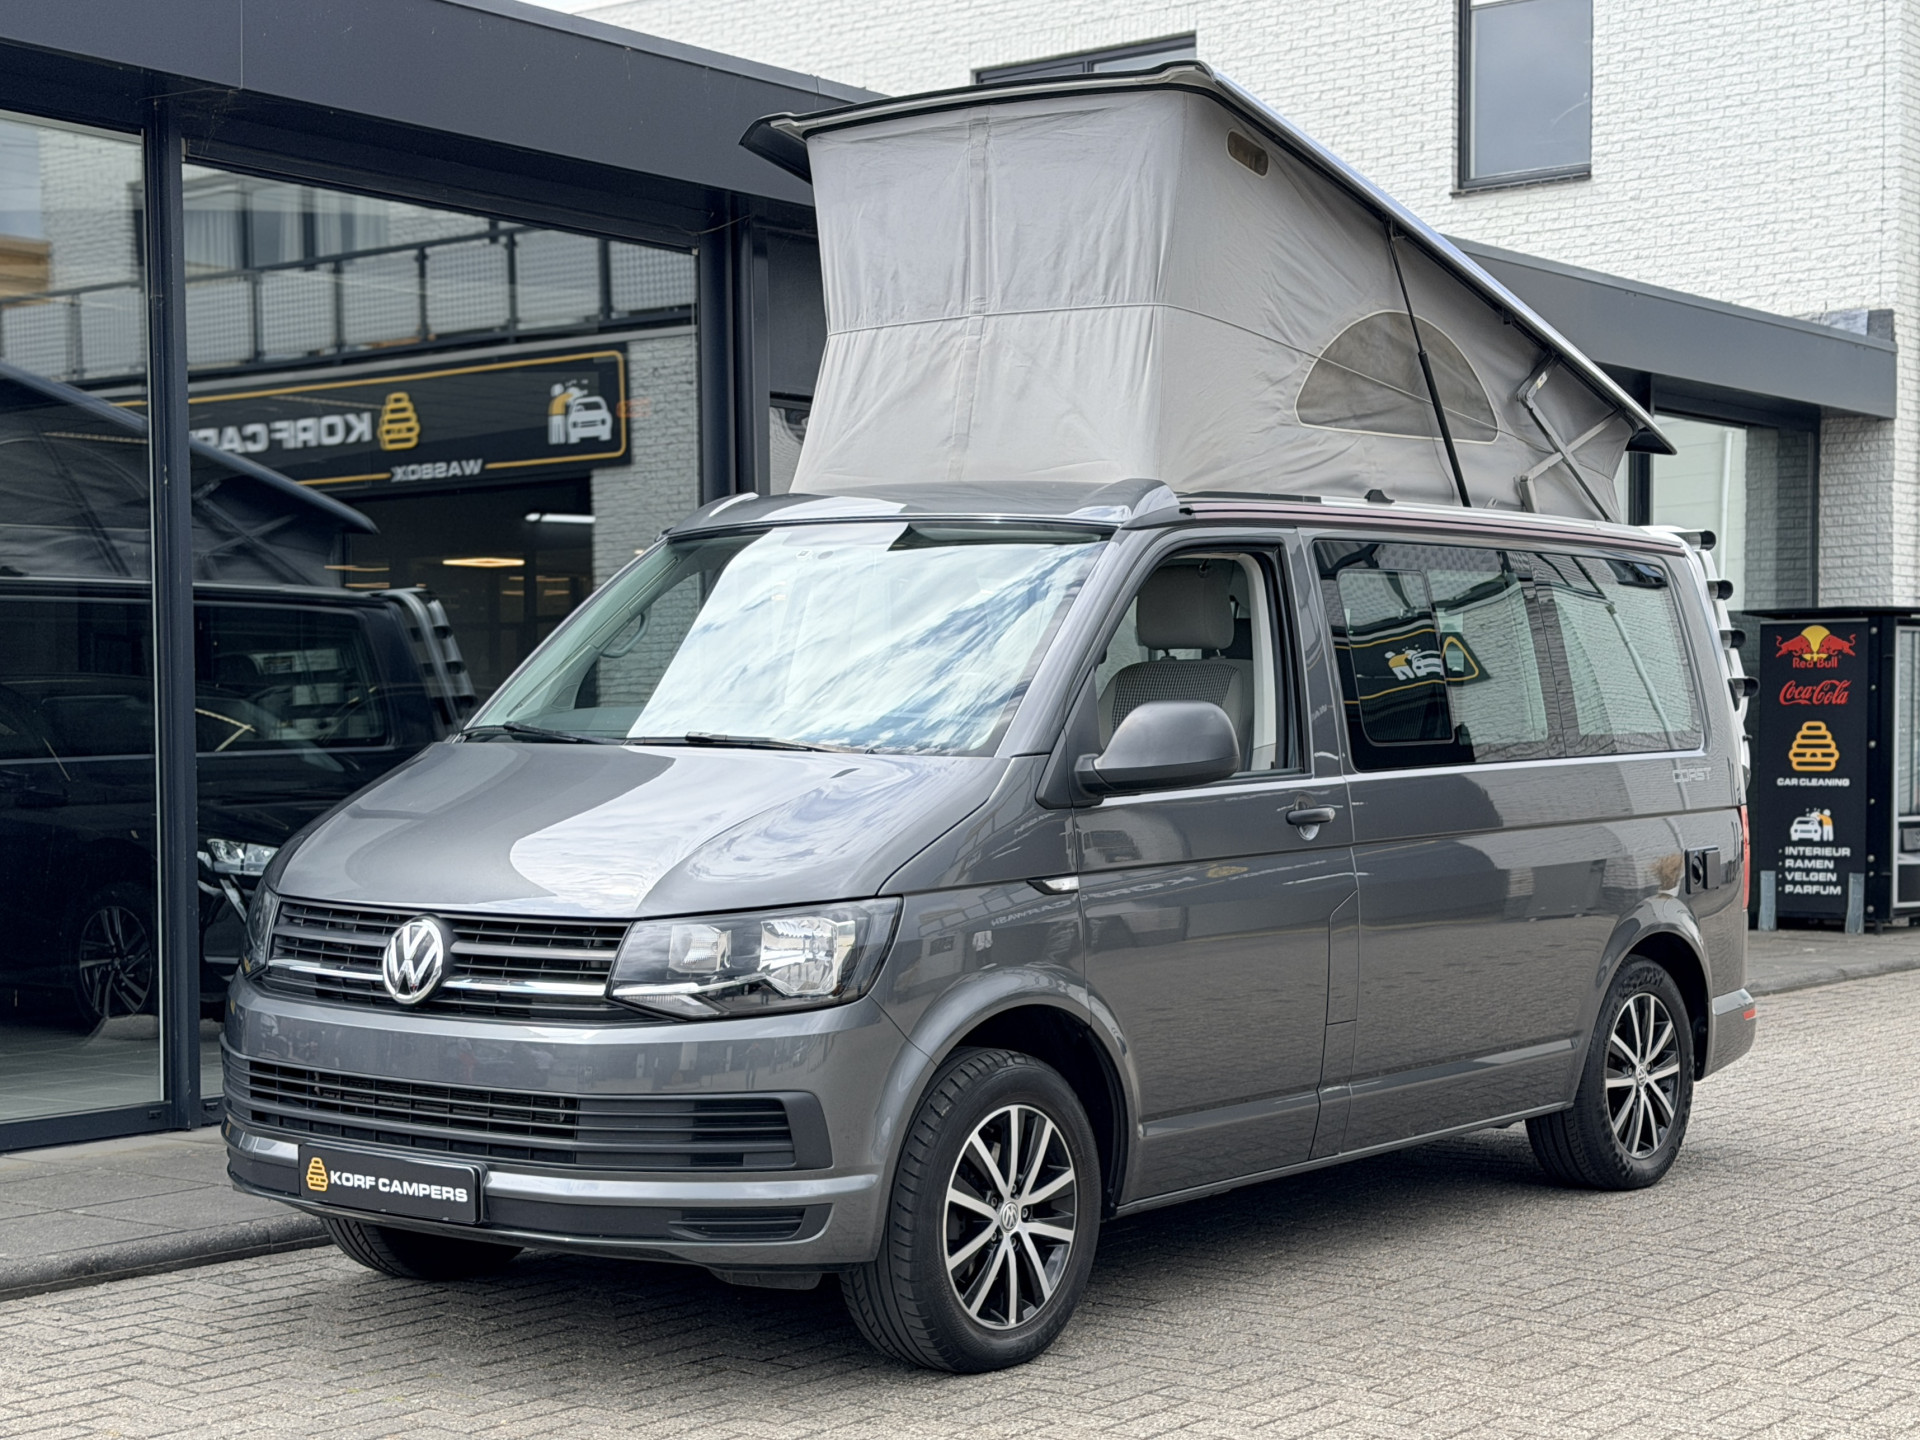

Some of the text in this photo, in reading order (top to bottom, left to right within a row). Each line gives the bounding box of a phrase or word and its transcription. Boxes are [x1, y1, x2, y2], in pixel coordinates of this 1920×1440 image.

[1793, 656, 1838, 668] Red Bull
[1779, 679, 1852, 706] Coca-Cola
[1777, 777, 1850, 787] CAR CLEANING
[1785, 847, 1851, 857] INTERIEUR
[1785, 859, 1834, 869] RAMEN
[1785, 871, 1837, 882] VELGEN
[1785, 884, 1842, 895] PARFUM
[329, 1169, 469, 1203] KORF CAMPERS
